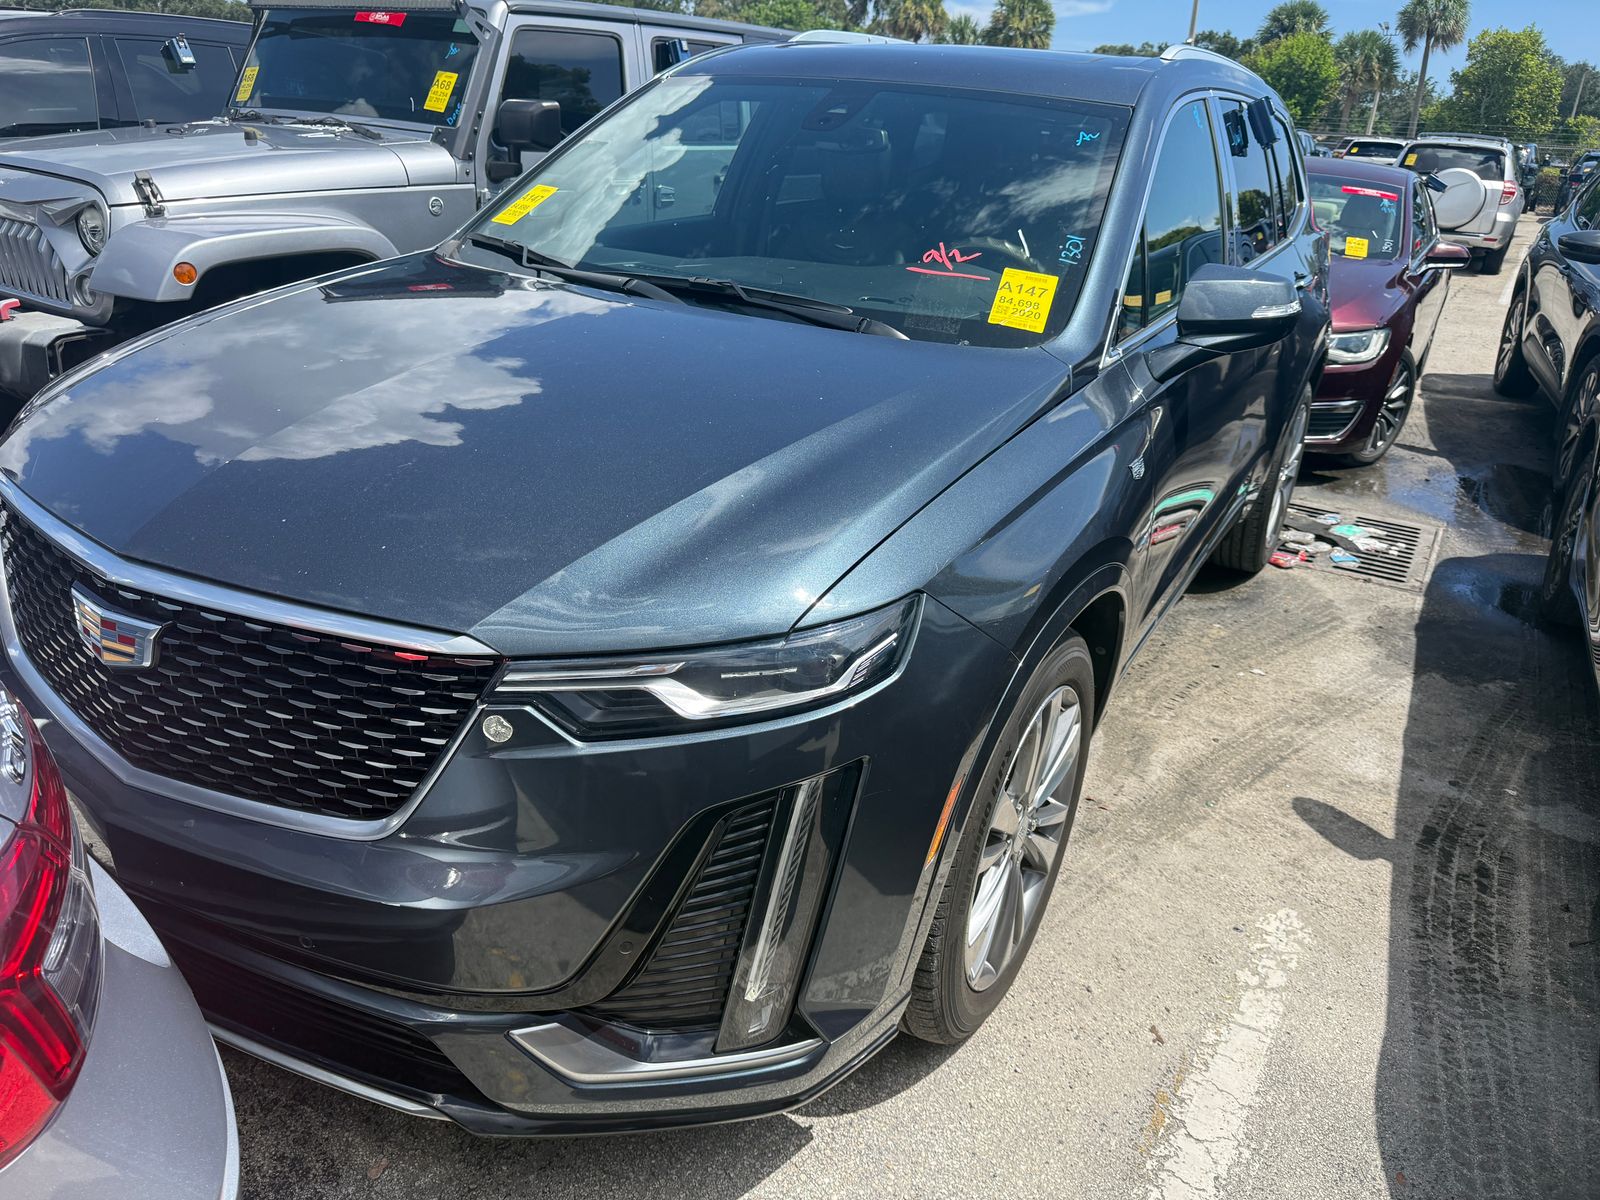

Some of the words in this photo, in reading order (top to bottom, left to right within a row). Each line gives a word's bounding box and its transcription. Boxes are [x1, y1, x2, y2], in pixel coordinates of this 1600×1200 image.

[432, 79, 452, 91] A68
[998, 281, 1049, 298] A147
[999, 295, 1041, 310] 84.698
[1010, 307, 1041, 320] 2020
